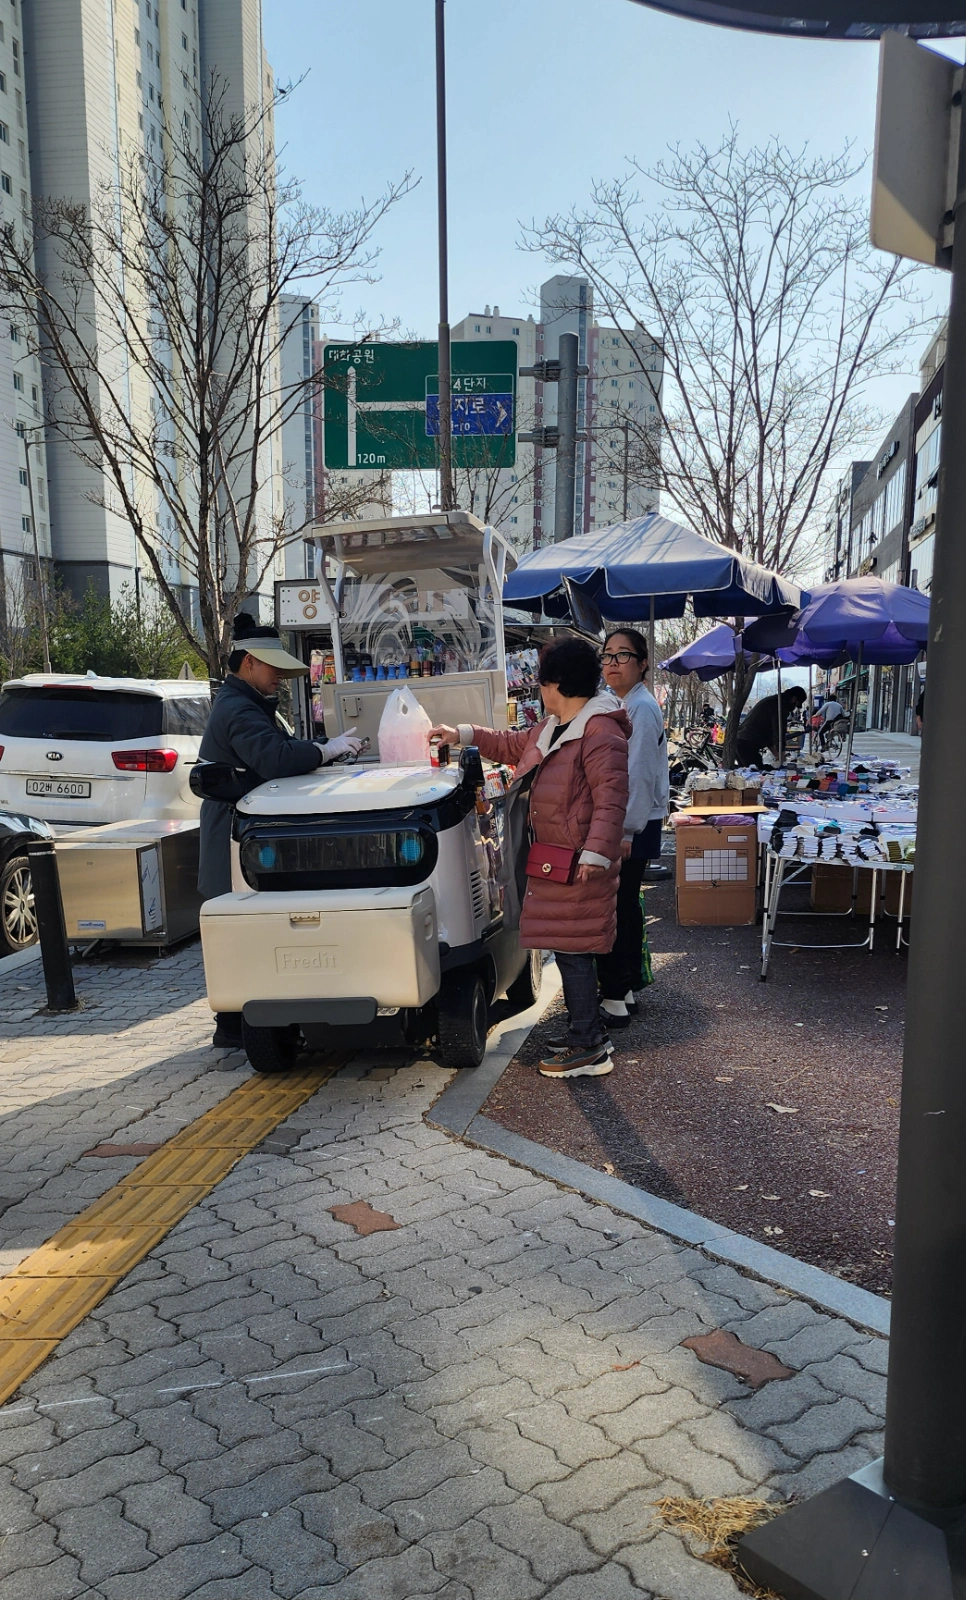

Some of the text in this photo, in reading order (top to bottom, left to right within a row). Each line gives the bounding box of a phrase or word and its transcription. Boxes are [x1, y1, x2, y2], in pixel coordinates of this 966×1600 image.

[328, 349, 375, 364] 대화공원
[453, 377, 486, 391] 4단지
[436, 397, 486, 415] 지로
[357, 453, 386, 464] 120m
[298, 588, 334, 619] 양
[47, 752, 60, 760] KIA
[32, 781, 84, 795] 02버 6600
